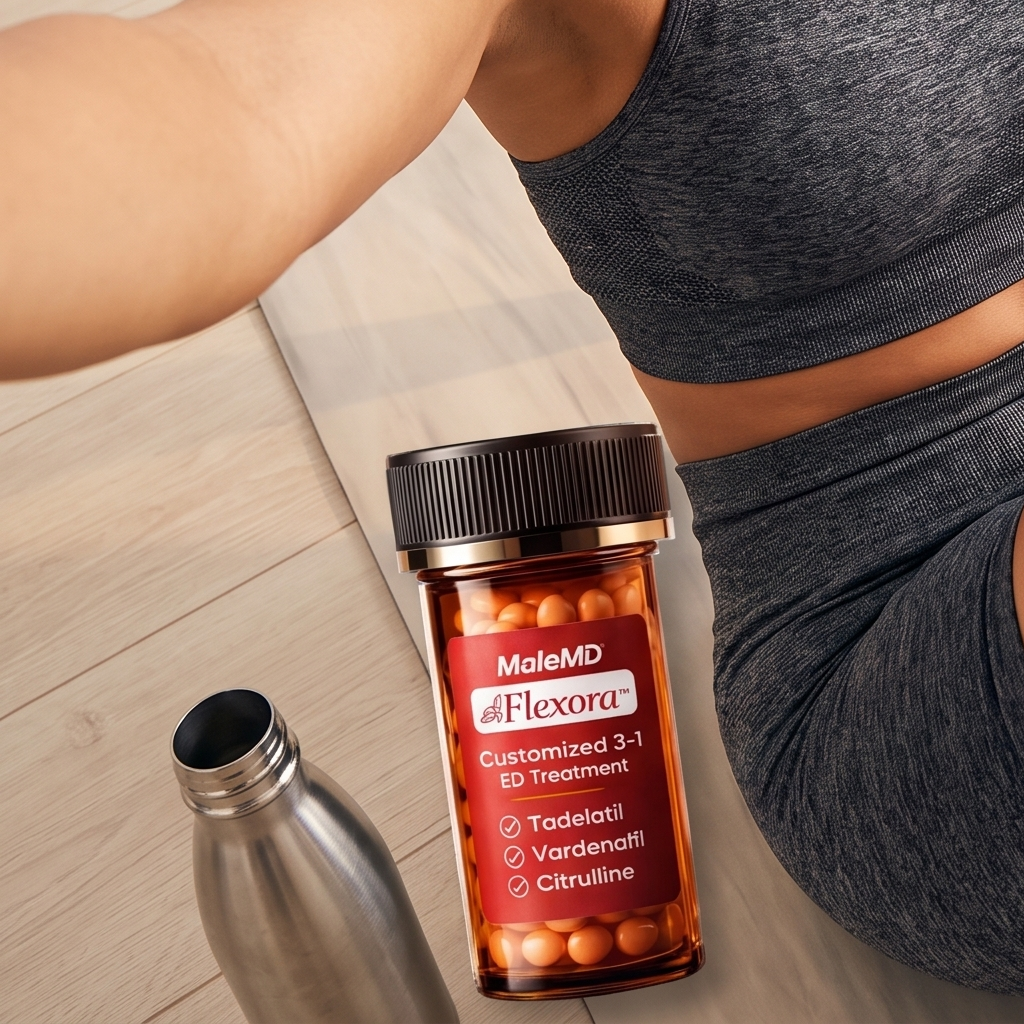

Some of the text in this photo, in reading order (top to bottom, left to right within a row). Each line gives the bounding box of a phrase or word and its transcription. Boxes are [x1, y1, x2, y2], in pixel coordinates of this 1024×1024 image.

[479, 731, 643, 768] Customized 3-1
[500, 758, 630, 789] ED Treatment
[527, 803, 624, 833] Tadelatil
[536, 865, 635, 892] Citrulline
